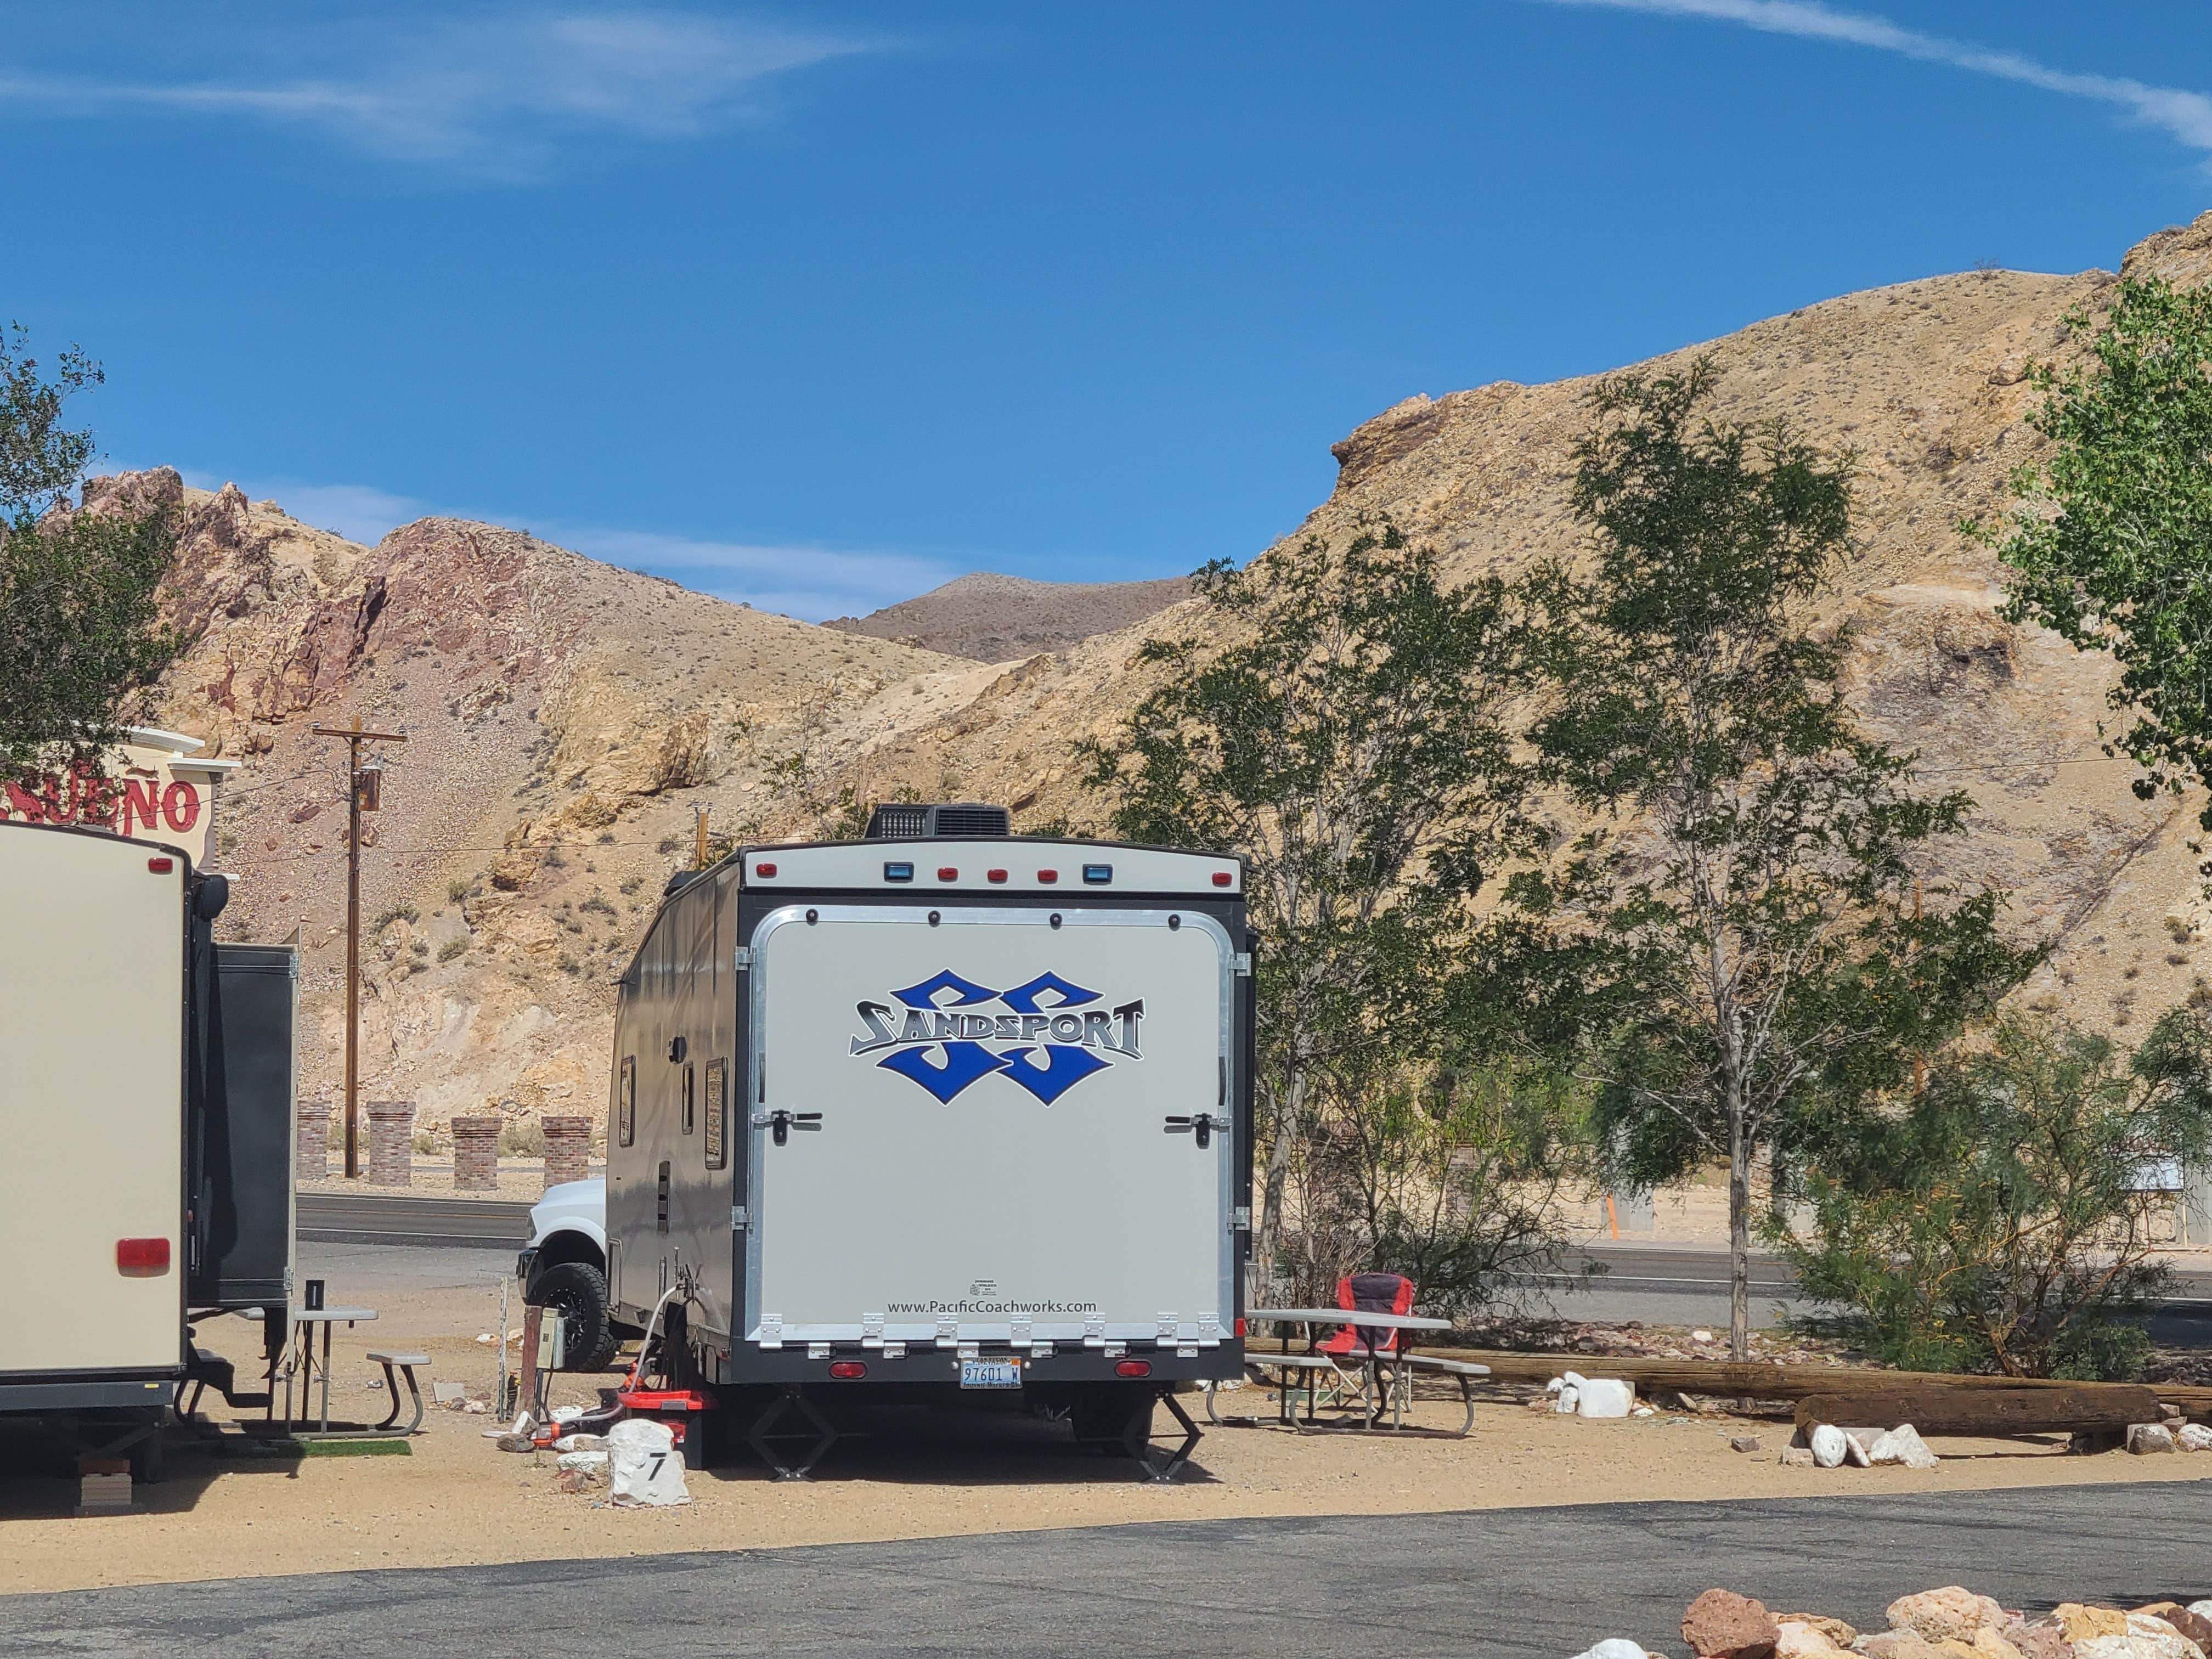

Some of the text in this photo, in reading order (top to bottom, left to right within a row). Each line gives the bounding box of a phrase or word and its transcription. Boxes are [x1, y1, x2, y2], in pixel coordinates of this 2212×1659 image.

[849, 997, 1145, 1060] SANDSPORT
[888, 1300, 1097, 1313] www.PacificCoachworks.com
[964, 1367, 1018, 1381] 97601 W
[648, 1452, 667, 1481] 7
